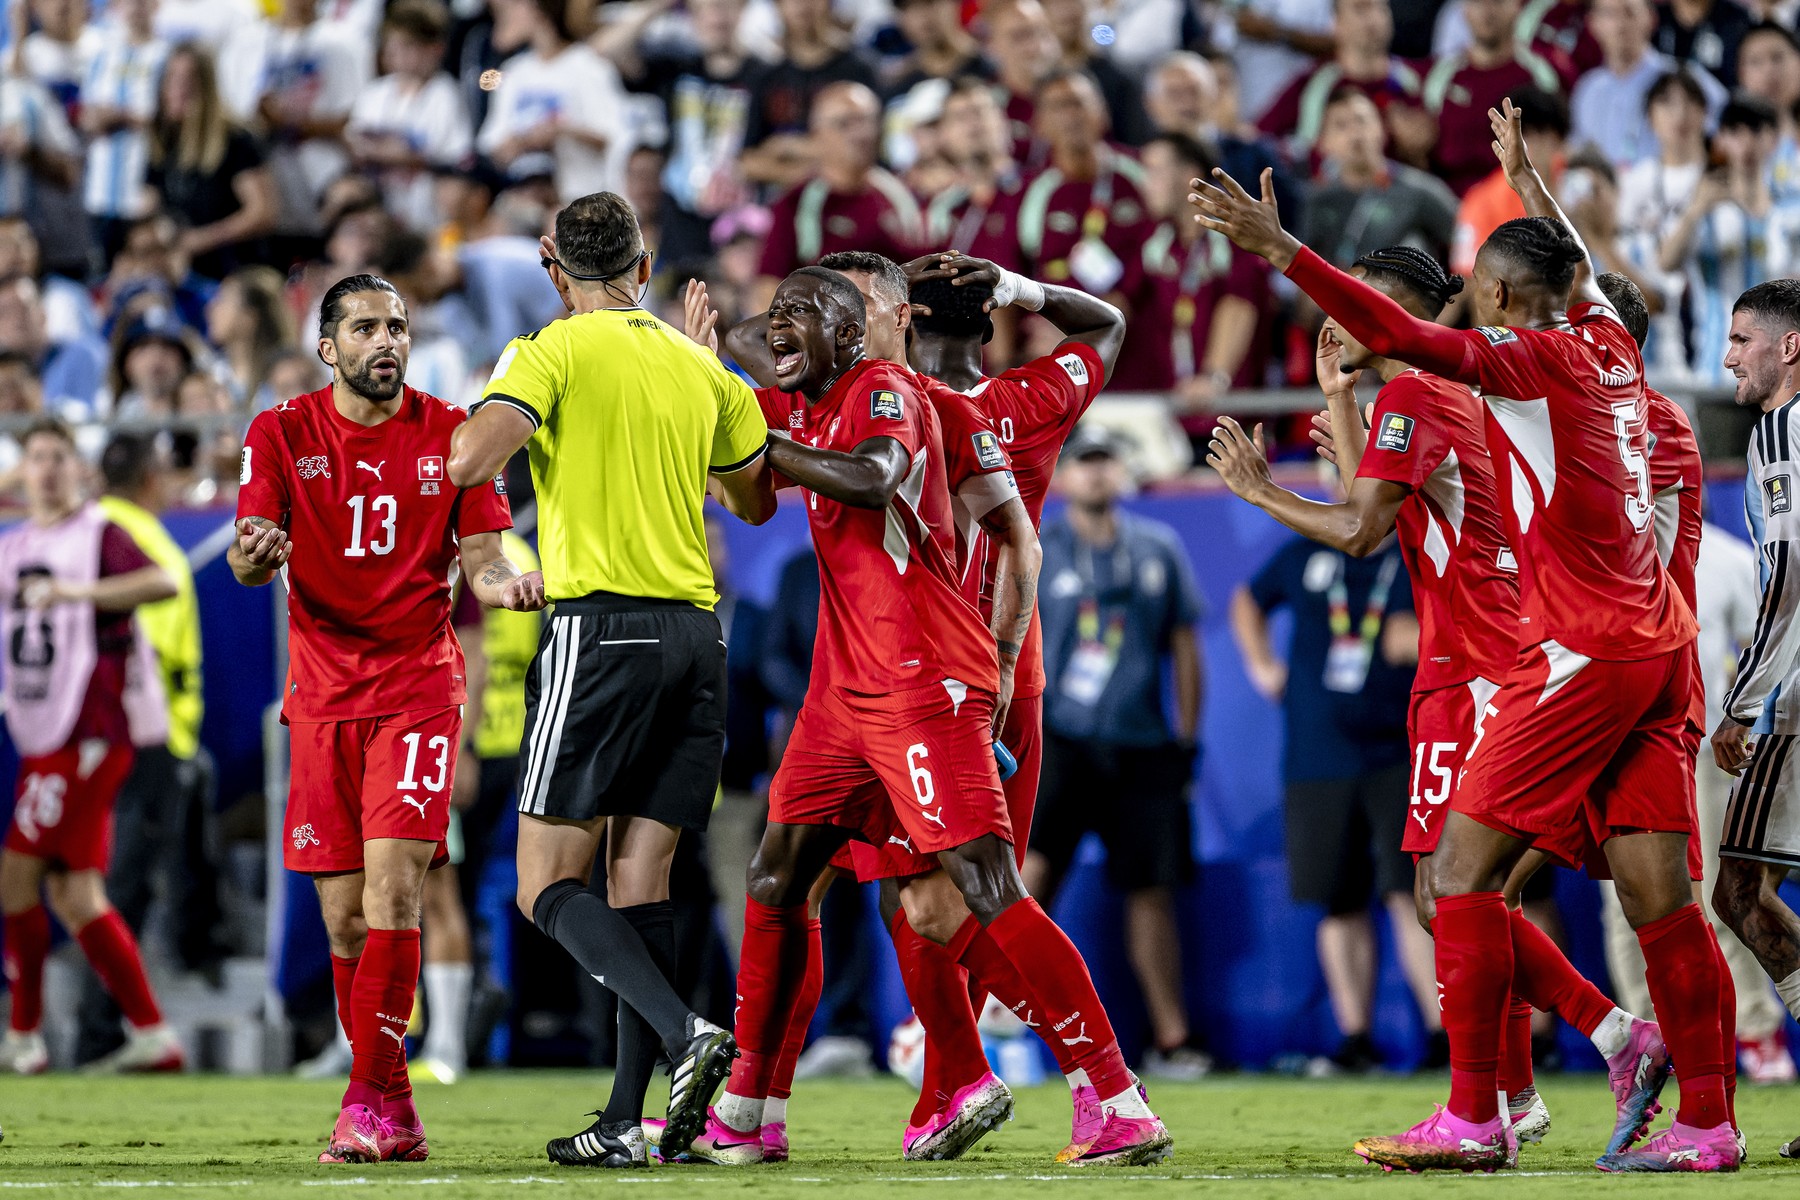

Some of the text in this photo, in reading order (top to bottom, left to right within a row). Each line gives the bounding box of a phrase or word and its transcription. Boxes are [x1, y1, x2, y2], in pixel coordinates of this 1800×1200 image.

[626, 318, 662, 330] PINHEI
[1611, 400, 1655, 534] 5
[344, 494, 397, 556] 13
[396, 732, 449, 792] 13
[906, 742, 935, 806] 6
[1410, 742, 1459, 805] 15
